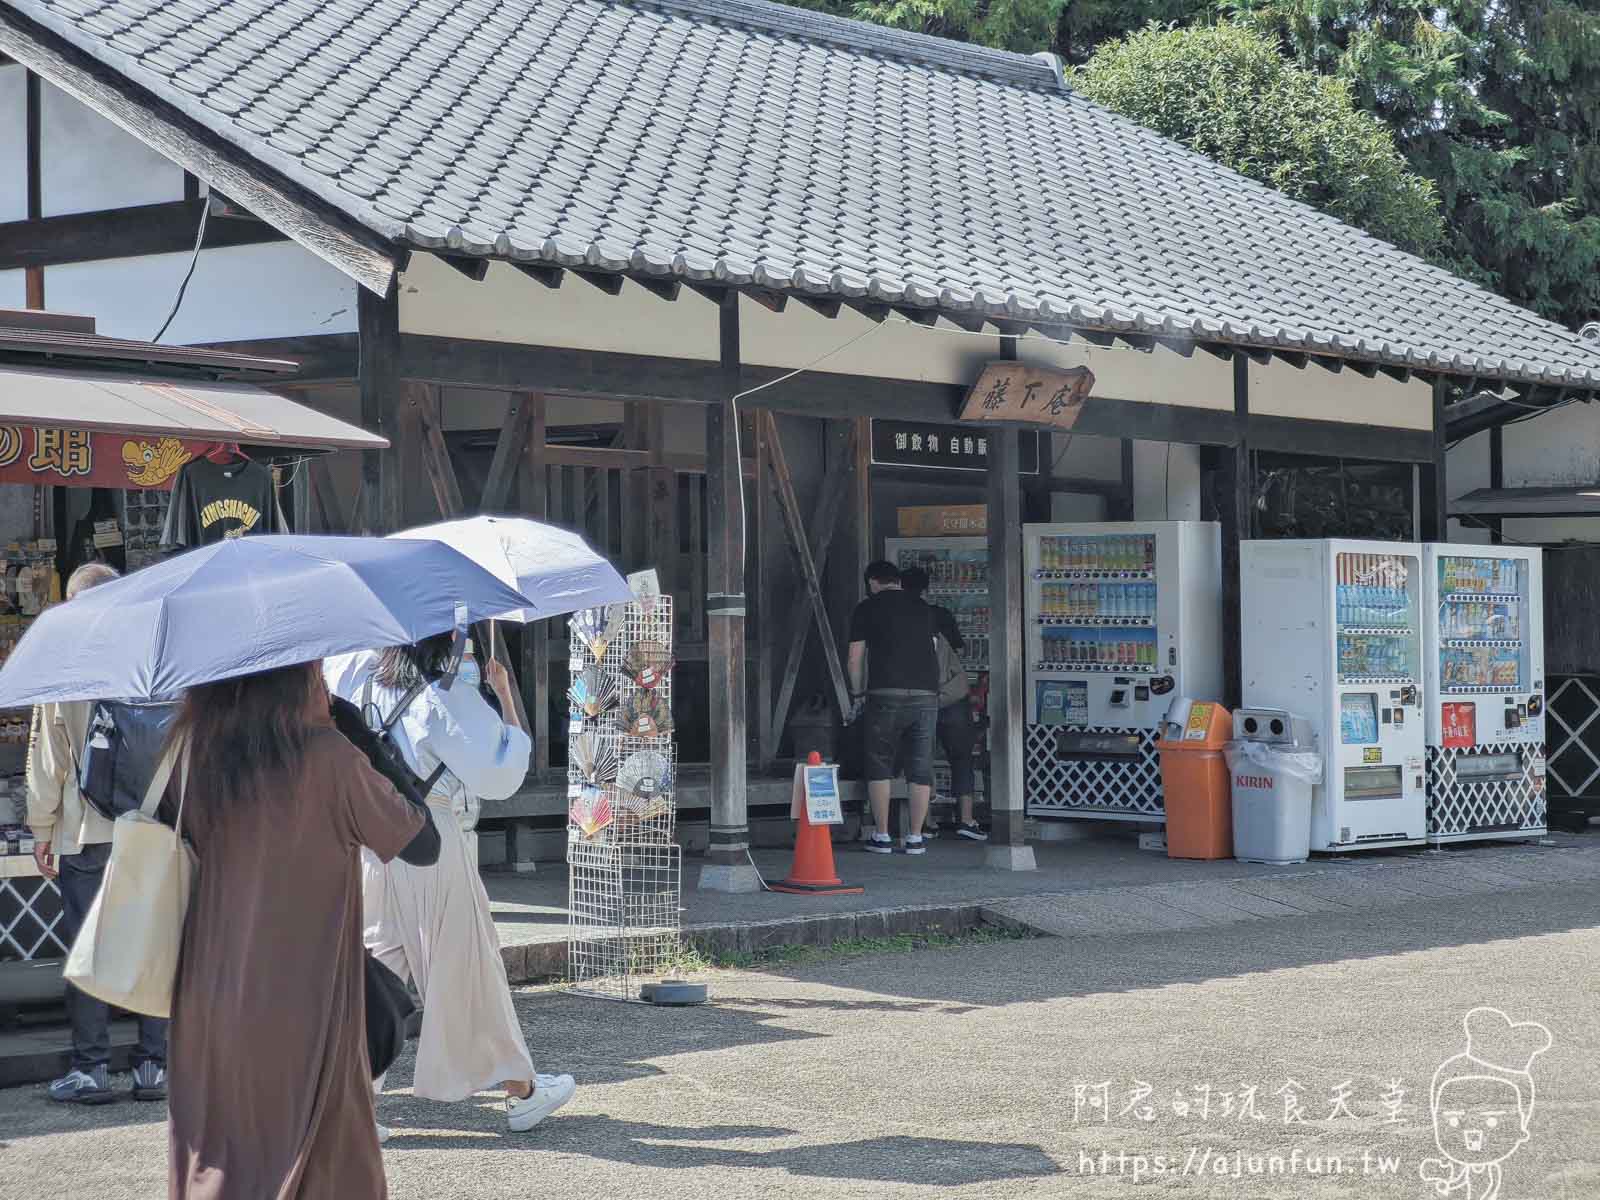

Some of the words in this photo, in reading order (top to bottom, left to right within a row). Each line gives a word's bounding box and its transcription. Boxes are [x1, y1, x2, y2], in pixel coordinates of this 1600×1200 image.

[895, 432, 940, 453] 御飲物
[200, 499, 261, 530] KINGSHACHI
[1236, 775, 1273, 789] KIRIN
